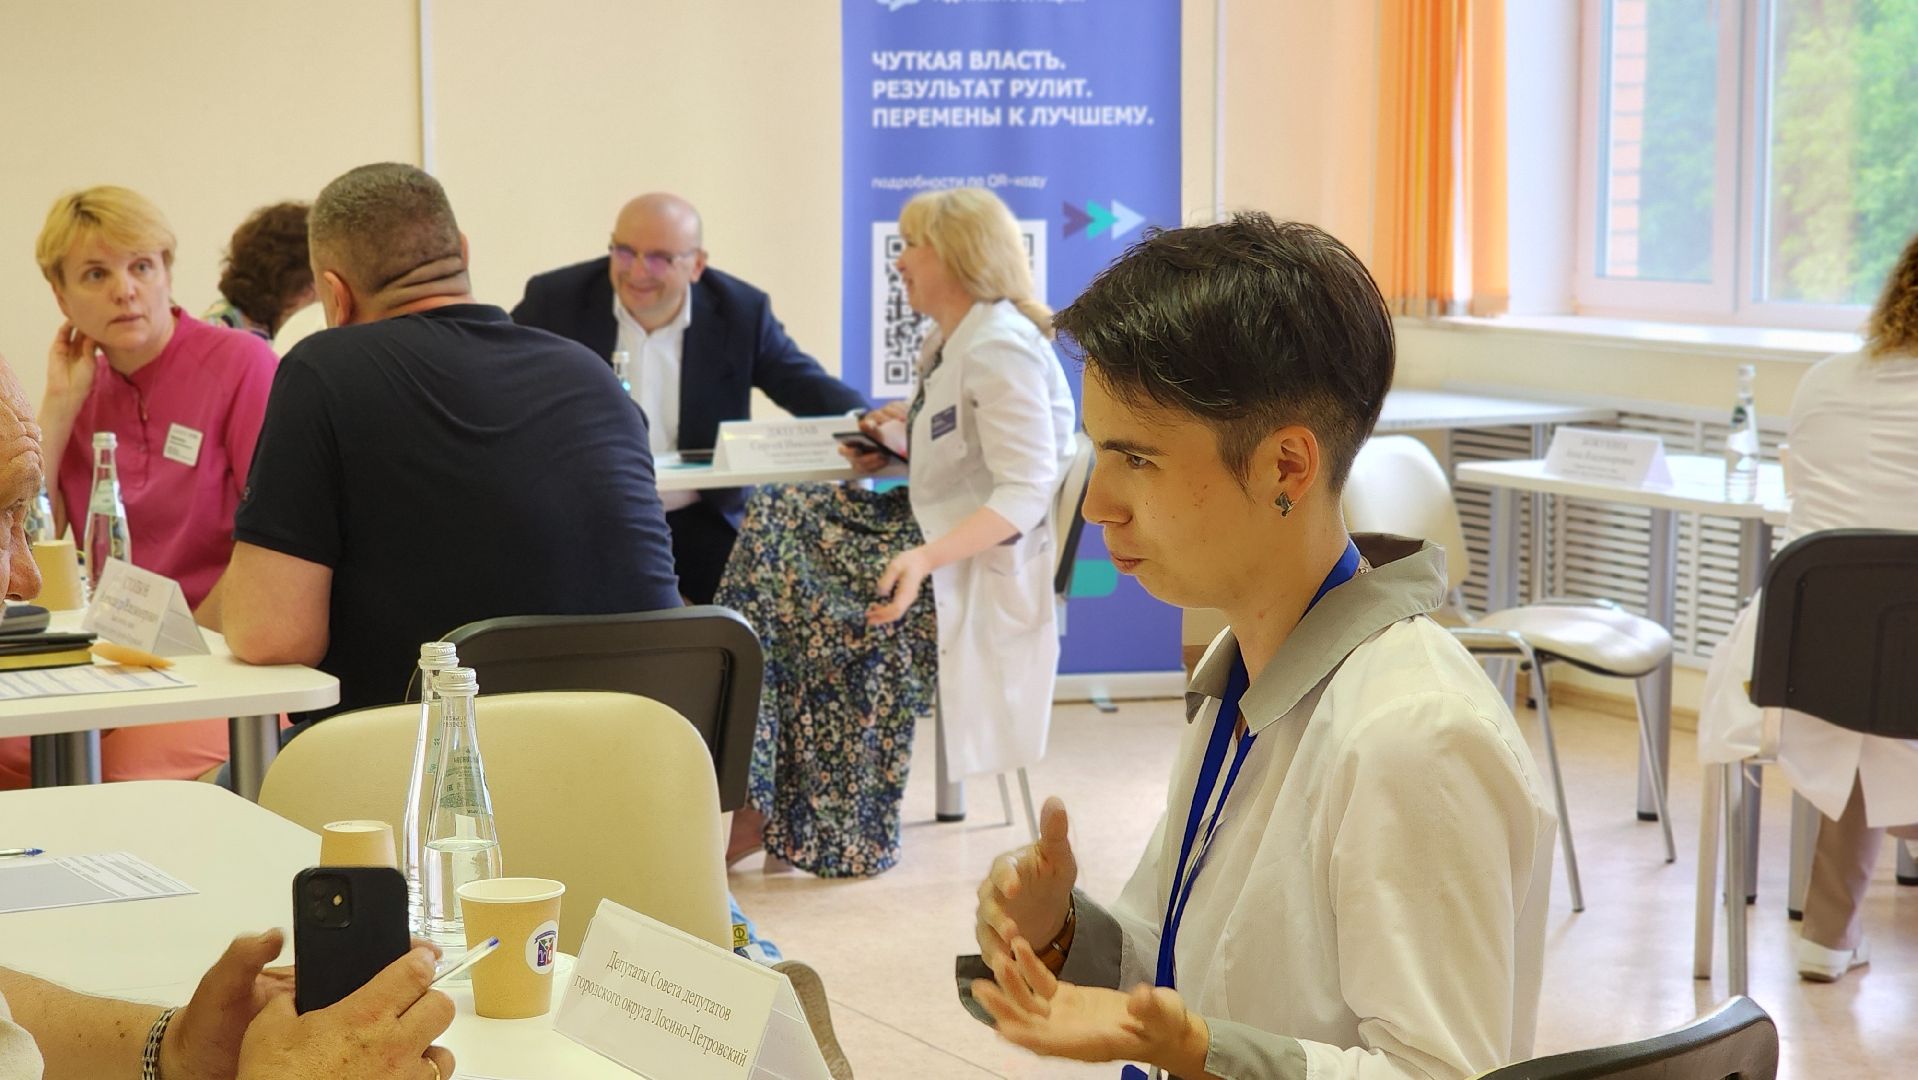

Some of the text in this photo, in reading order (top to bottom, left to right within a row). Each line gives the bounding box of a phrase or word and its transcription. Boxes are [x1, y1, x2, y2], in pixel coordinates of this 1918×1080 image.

[871, 51, 1067, 71] ЧУТКАЯ ВЛАСТЬ.
[872, 79, 1093, 99] РЕЗУЛЬТАТ РУЛИТ.
[872, 106, 1154, 128] ПЕРЕМЕНЫ К ЛУЧШЕМУ.
[871, 175, 964, 190] подробности
[606, 950, 732, 1022] Депутаты Совета депутатов
[573, 975, 749, 1068] городского округа Лосино-Петровский
